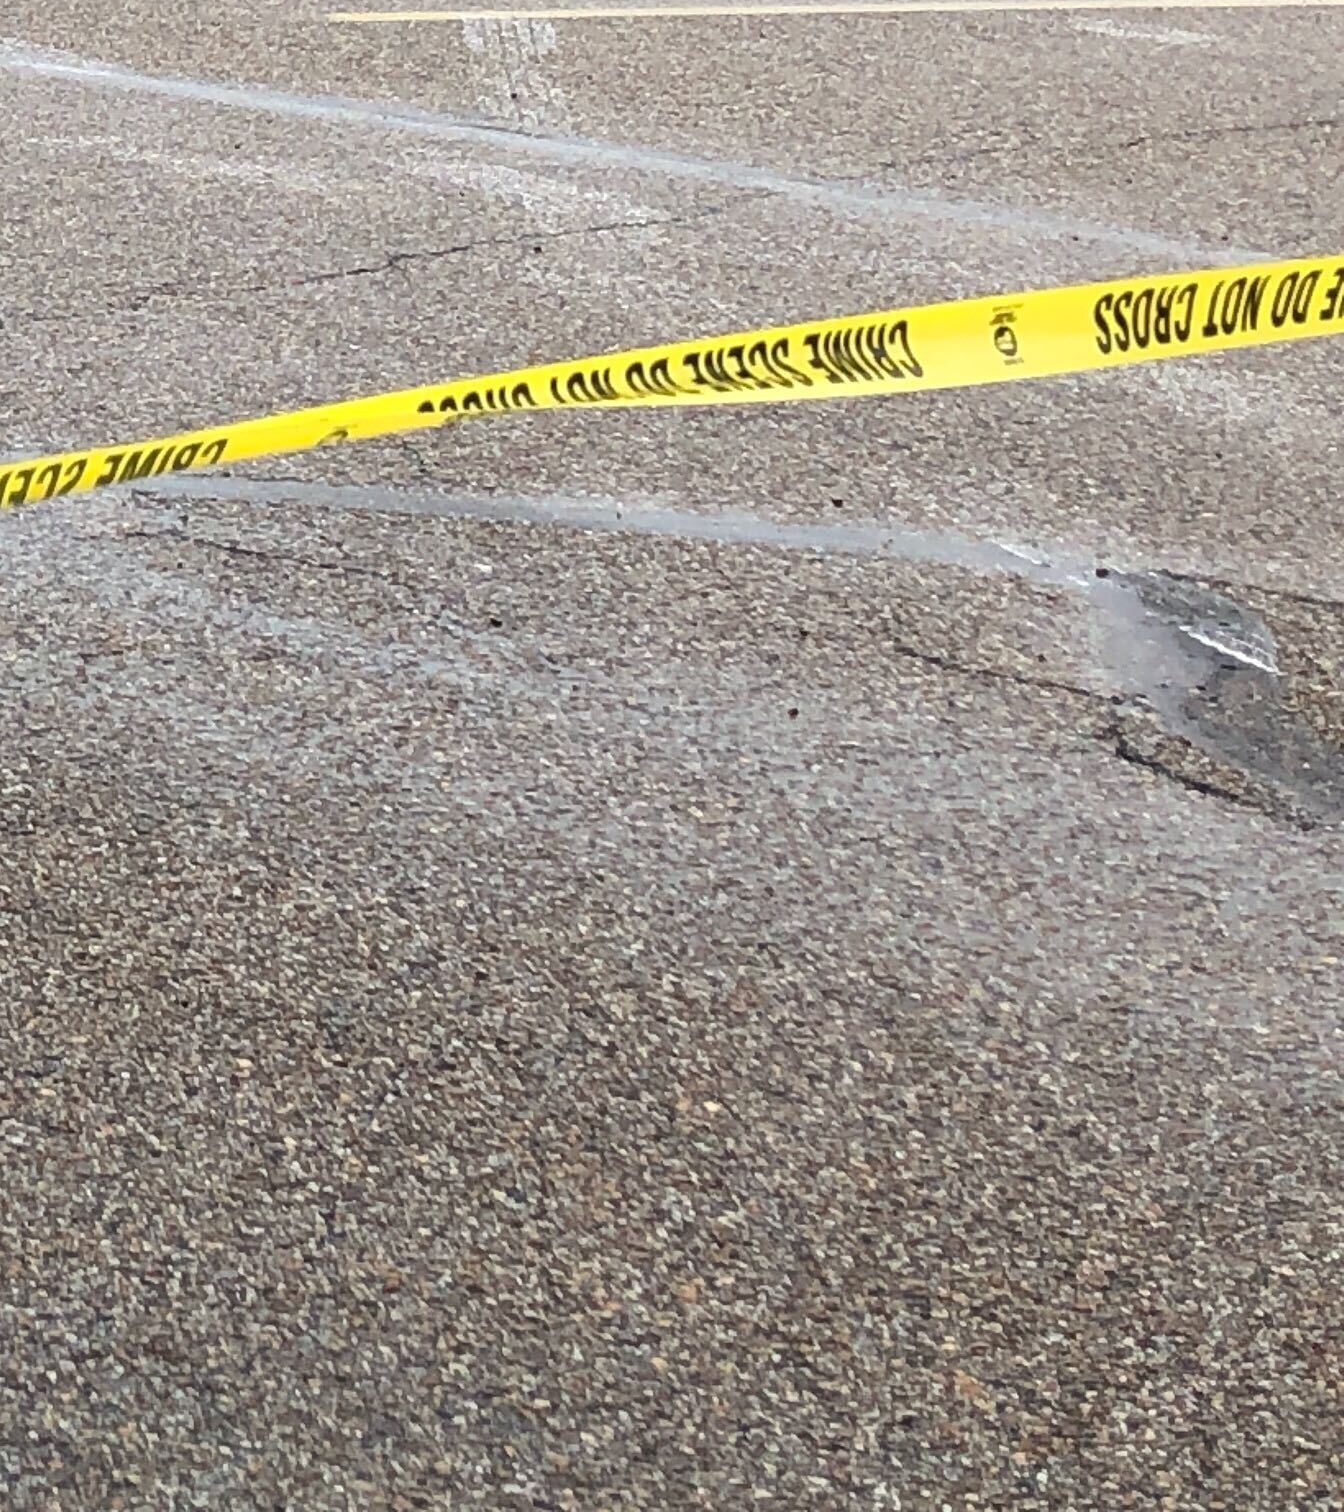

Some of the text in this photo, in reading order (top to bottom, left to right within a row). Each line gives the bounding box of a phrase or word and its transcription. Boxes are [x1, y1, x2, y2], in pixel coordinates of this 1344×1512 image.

[1093, 282, 1199, 355] CROSS
[1202, 274, 1273, 338] NOT
[1271, 269, 1323, 328] DO
[803, 320, 923, 384] CRIME
